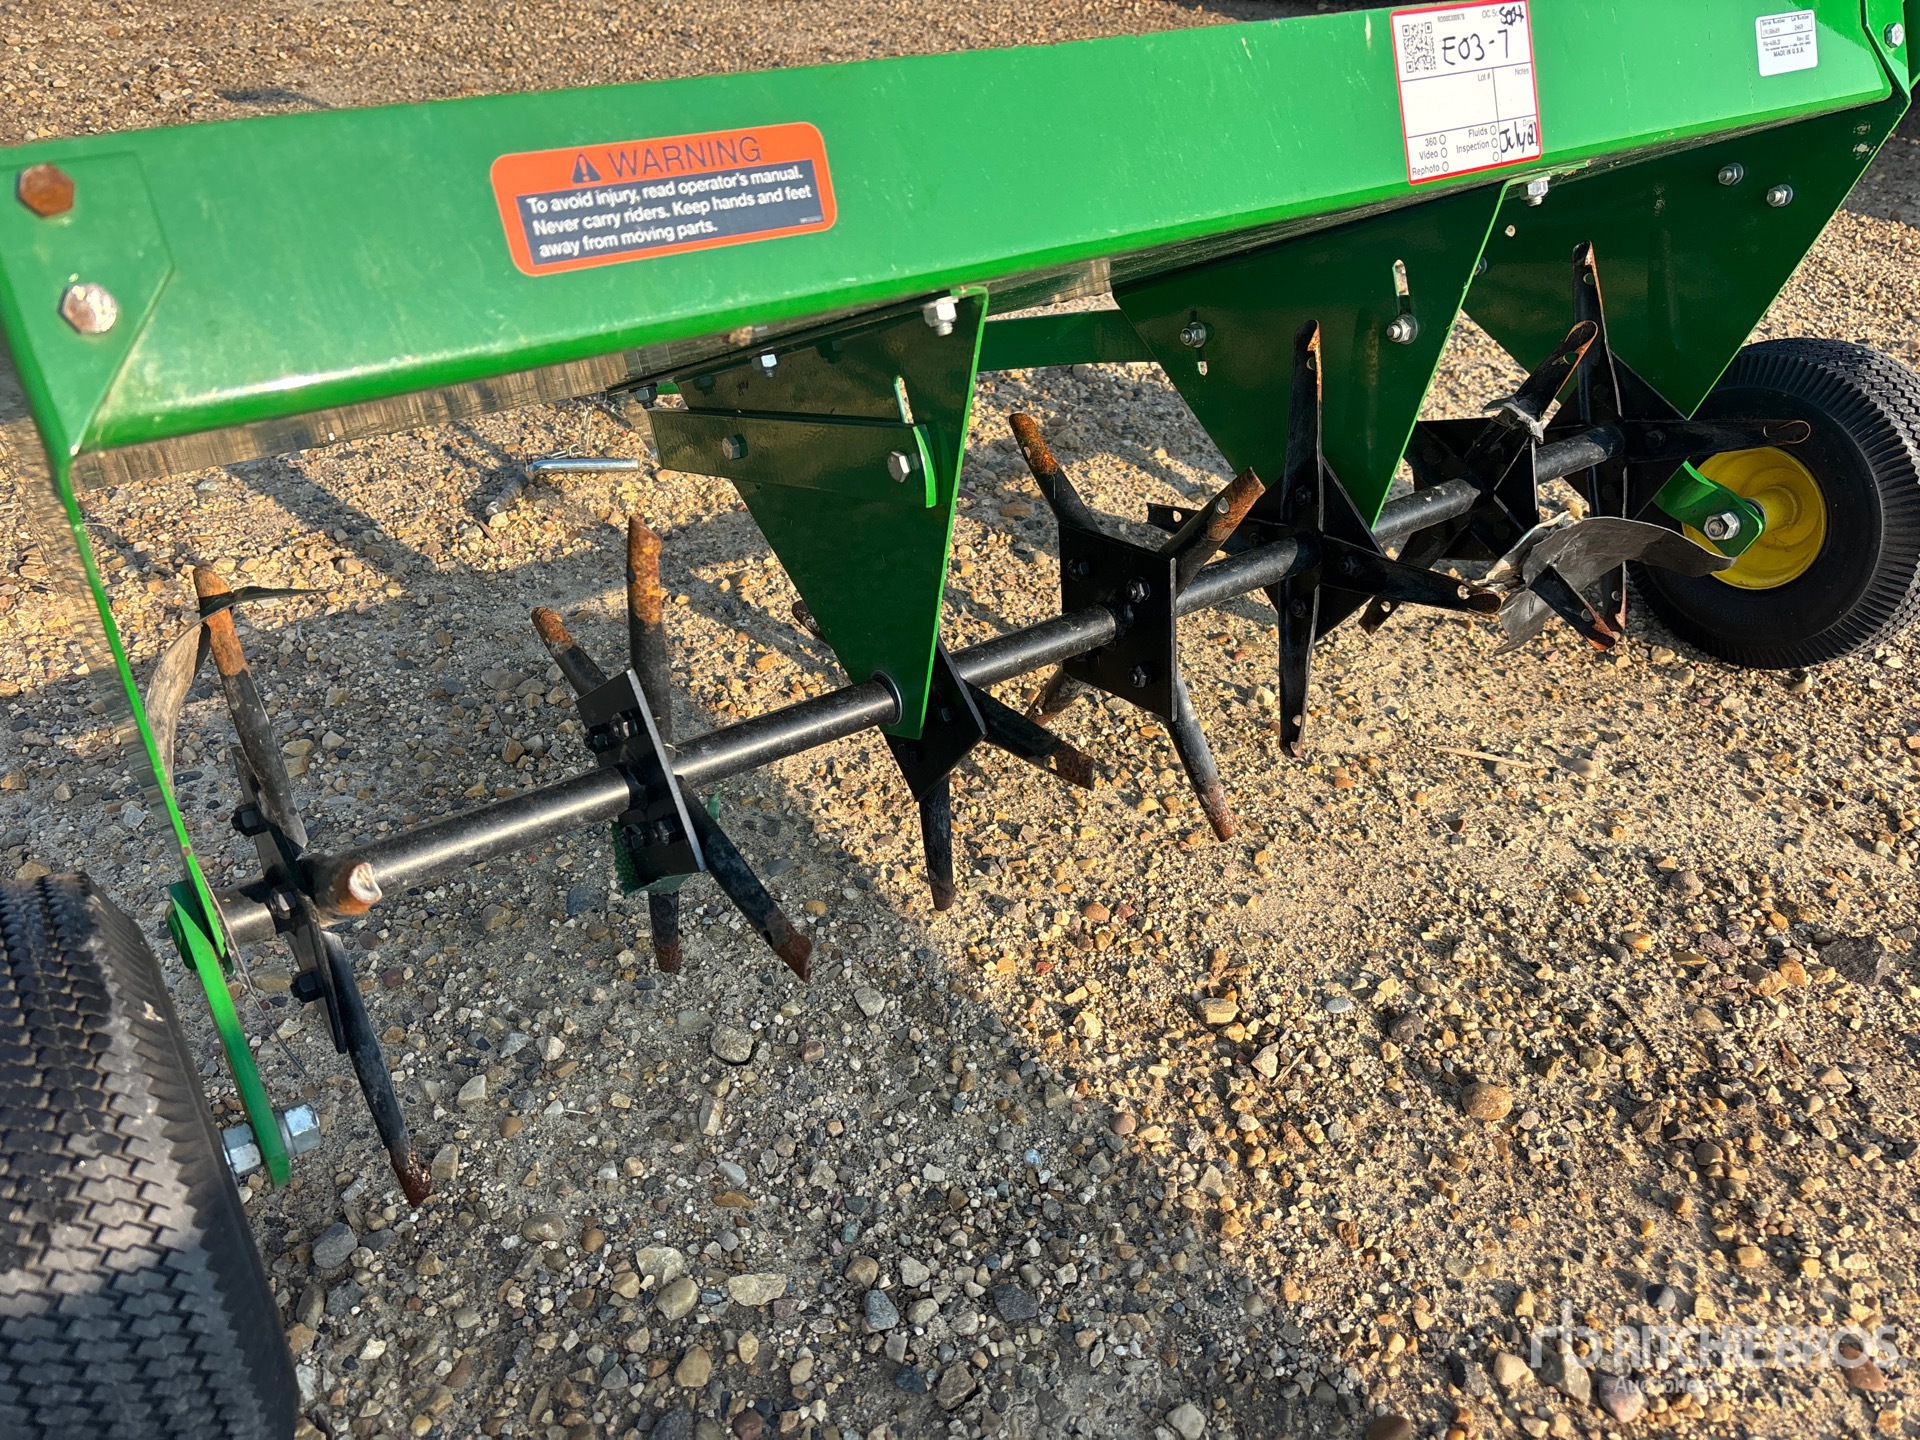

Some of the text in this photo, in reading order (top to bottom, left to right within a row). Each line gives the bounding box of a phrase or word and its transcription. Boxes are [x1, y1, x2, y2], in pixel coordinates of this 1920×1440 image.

[1515, 68, 1529, 76] Notes
[1468, 128, 1488, 138] Fluids
[1425, 136, 1437, 147] 360
[1456, 140, 1490, 154] Inspection
[607, 136, 762, 178] WARNING
[1419, 151, 1438, 160] Video
[1412, 165, 1440, 177] Rephoto
[526, 165, 803, 214] To avoid injury, read operator's manual.
[533, 184, 812, 236] Never carry riders. Keep hands and feet
[538, 219, 718, 259] away from moving parts.
